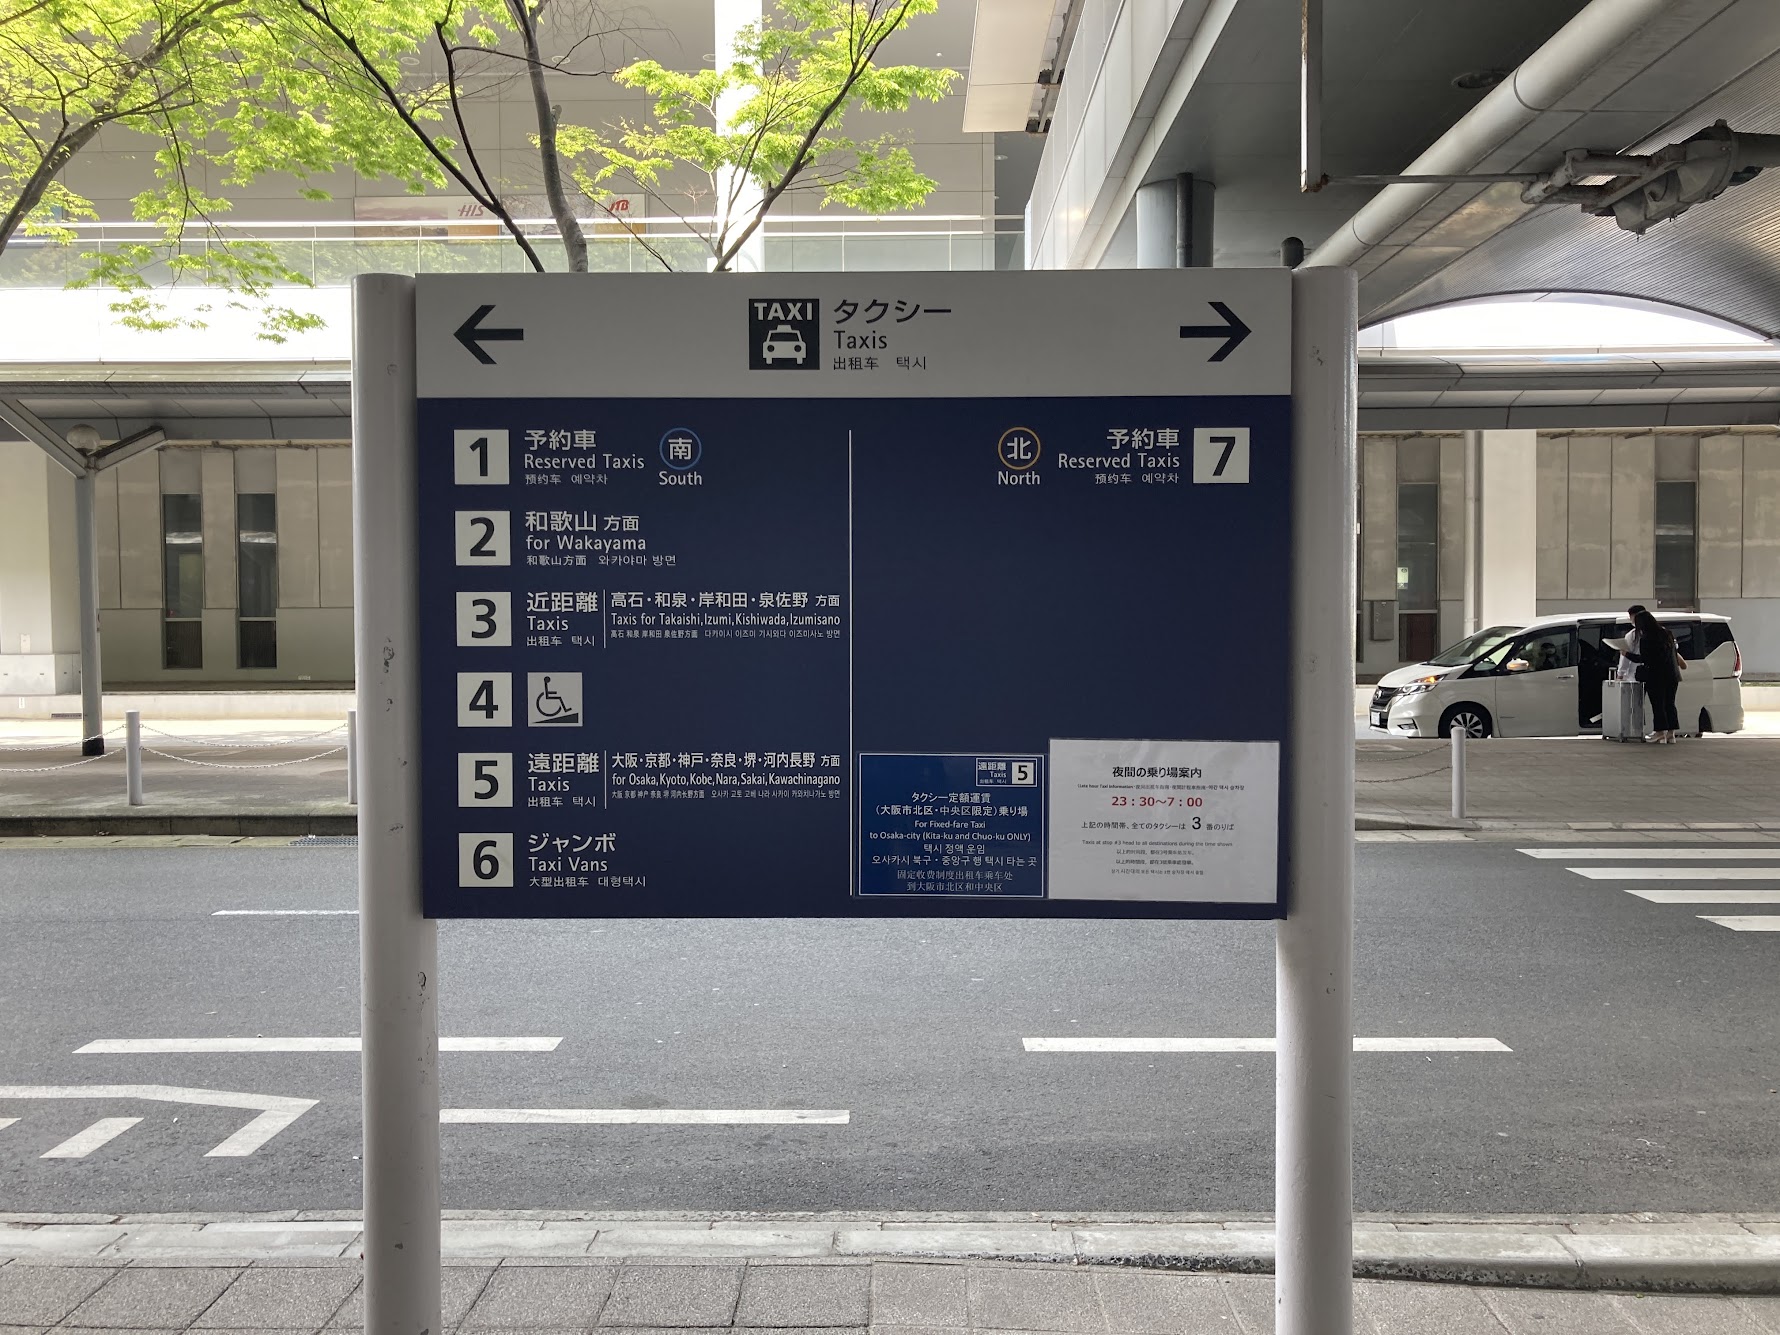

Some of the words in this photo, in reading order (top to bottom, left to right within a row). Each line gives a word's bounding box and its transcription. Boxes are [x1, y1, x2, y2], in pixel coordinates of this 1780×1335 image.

[754, 302, 812, 320] TAXI
[834, 299, 951, 323] タクシー
[834, 330, 887, 349] Taxis
[834, 356, 879, 370] 出租车
[896, 356, 926, 370] 택시
[524, 430, 596, 450] 予約車
[1107, 428, 1179, 449] 予約車
[669, 439, 692, 460] 南
[1006, 437, 1031, 459] 北
[469, 437, 488, 477] 1
[524, 453, 596, 469] Reserved
[603, 453, 644, 469] Taxis
[1058, 453, 1130, 468] Reserved
[1138, 453, 1180, 468] Taxis
[1209, 436, 1235, 476] 7
[525, 474, 561, 485] 预约车
[571, 474, 608, 485] 예약차
[659, 471, 702, 485] South
[998, 471, 1040, 485] North
[1095, 473, 1131, 484] 预约车
[1142, 473, 1179, 484] 예약차
[525, 511, 597, 531] 和歌山
[604, 515, 639, 531] 方面
[469, 517, 496, 556] 2
[526, 535, 549, 550] for
[556, 535, 646, 552] Wakayama
[526, 555, 587, 566] 和歌山方面
[599, 555, 647, 566] 와카야마
[653, 555, 676, 566] 방면
[527, 592, 598, 613] 近距離
[816, 595, 840, 607] 方面
[472, 599, 496, 638] 3
[527, 616, 568, 630] Taxis
[611, 613, 637, 625] Taxis
[641, 613, 656, 625] for
[527, 636, 562, 646] 出租车
[571, 636, 595, 646] 택시
[469, 680, 498, 719] 4
[528, 753, 599, 773] 遠距離
[821, 755, 840, 767] 方面
[978, 762, 1006, 770] 遠距離
[612, 774, 625, 785] for
[1018, 765, 1028, 780] 5
[1112, 766, 1202, 778] 夜間の乗り場案内
[474, 760, 498, 800] 5
[529, 777, 570, 792] Taxis
[528, 797, 563, 807] 出租车
[573, 797, 595, 807] 택시
[912, 792, 991, 803] タクシー定額運賃
[1192, 817, 1201, 830] 3
[528, 833, 616, 853] ジャンボ
[880, 832, 920, 840] Osaka-city
[923, 832, 953, 840] (Kita-ku
[1007, 833, 1031, 842] ONLY)
[924, 844, 941, 854] 택시
[945, 844, 963, 854] 정액
[967, 844, 985, 854] 운임
[473, 841, 499, 879] 6
[529, 857, 562, 872] Taxi
[569, 857, 607, 872] Vans
[872, 856, 910, 866] 오사카시
[973, 856, 982, 866] 행
[985, 856, 1003, 866] 택시
[1007, 856, 1025, 866] 타는
[1028, 856, 1037, 866] 곳
[529, 877, 589, 888] 大型出租车
[598, 877, 646, 888] 대형택시
